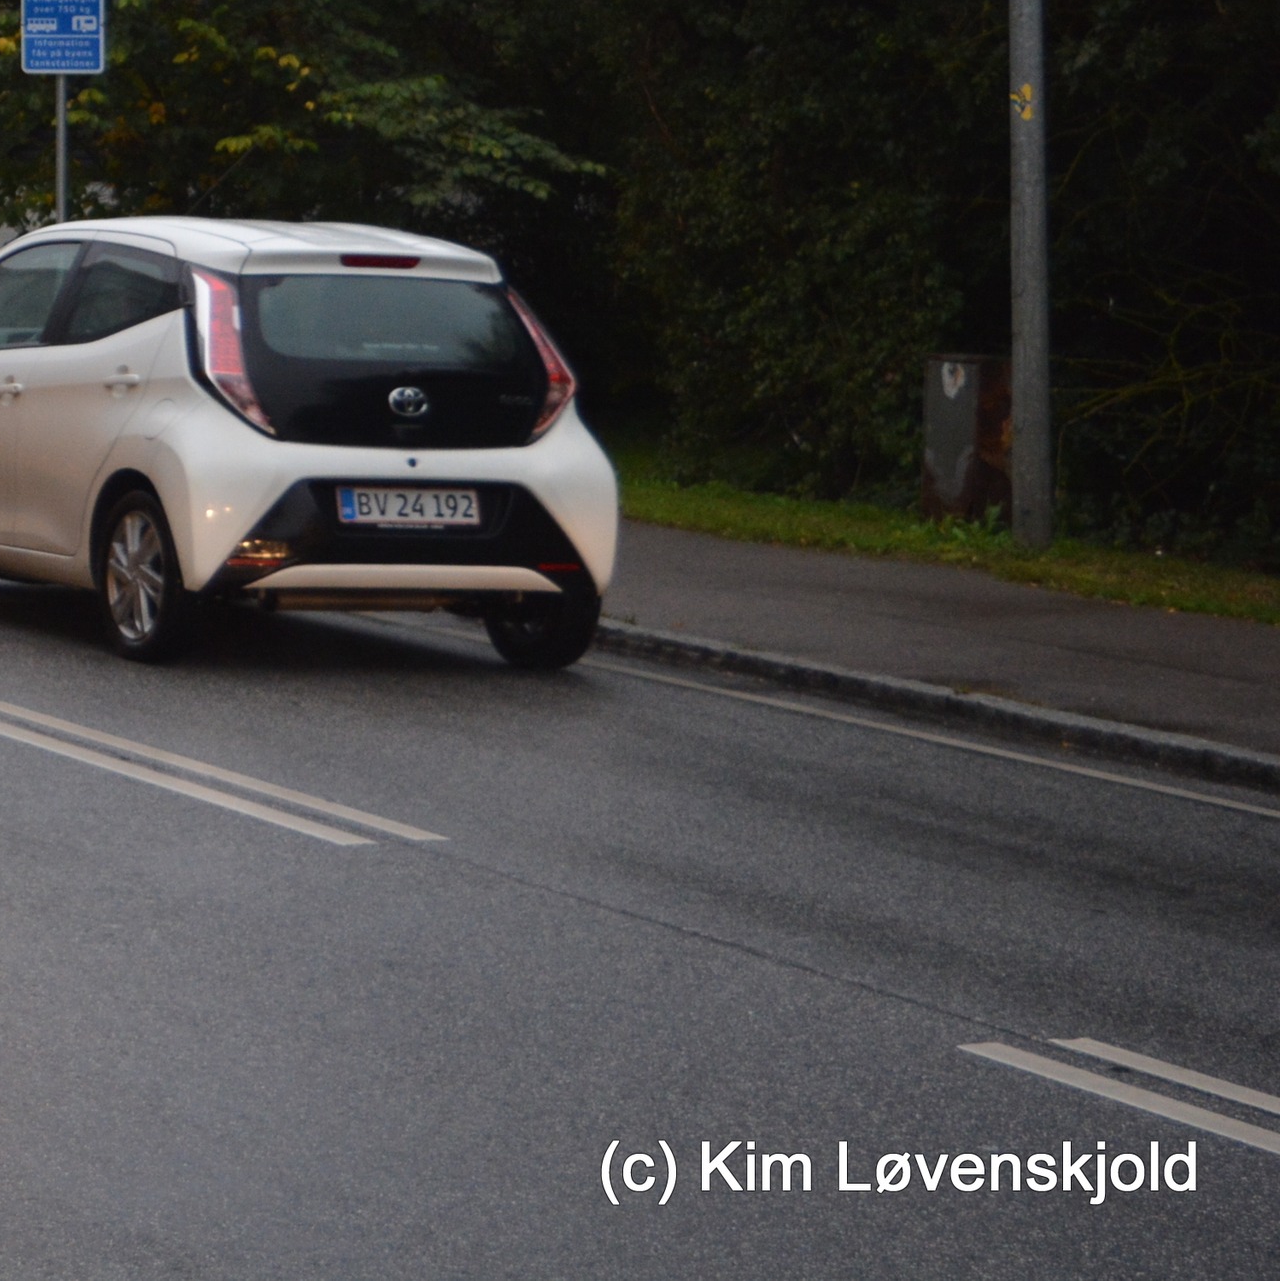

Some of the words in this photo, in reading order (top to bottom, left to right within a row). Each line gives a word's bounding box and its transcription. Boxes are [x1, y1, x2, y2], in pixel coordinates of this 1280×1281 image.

[34, 39, 90, 47] Information
[357, 493, 388, 516] BV
[396, 494, 424, 517] 24
[433, 495, 474, 518] 192
